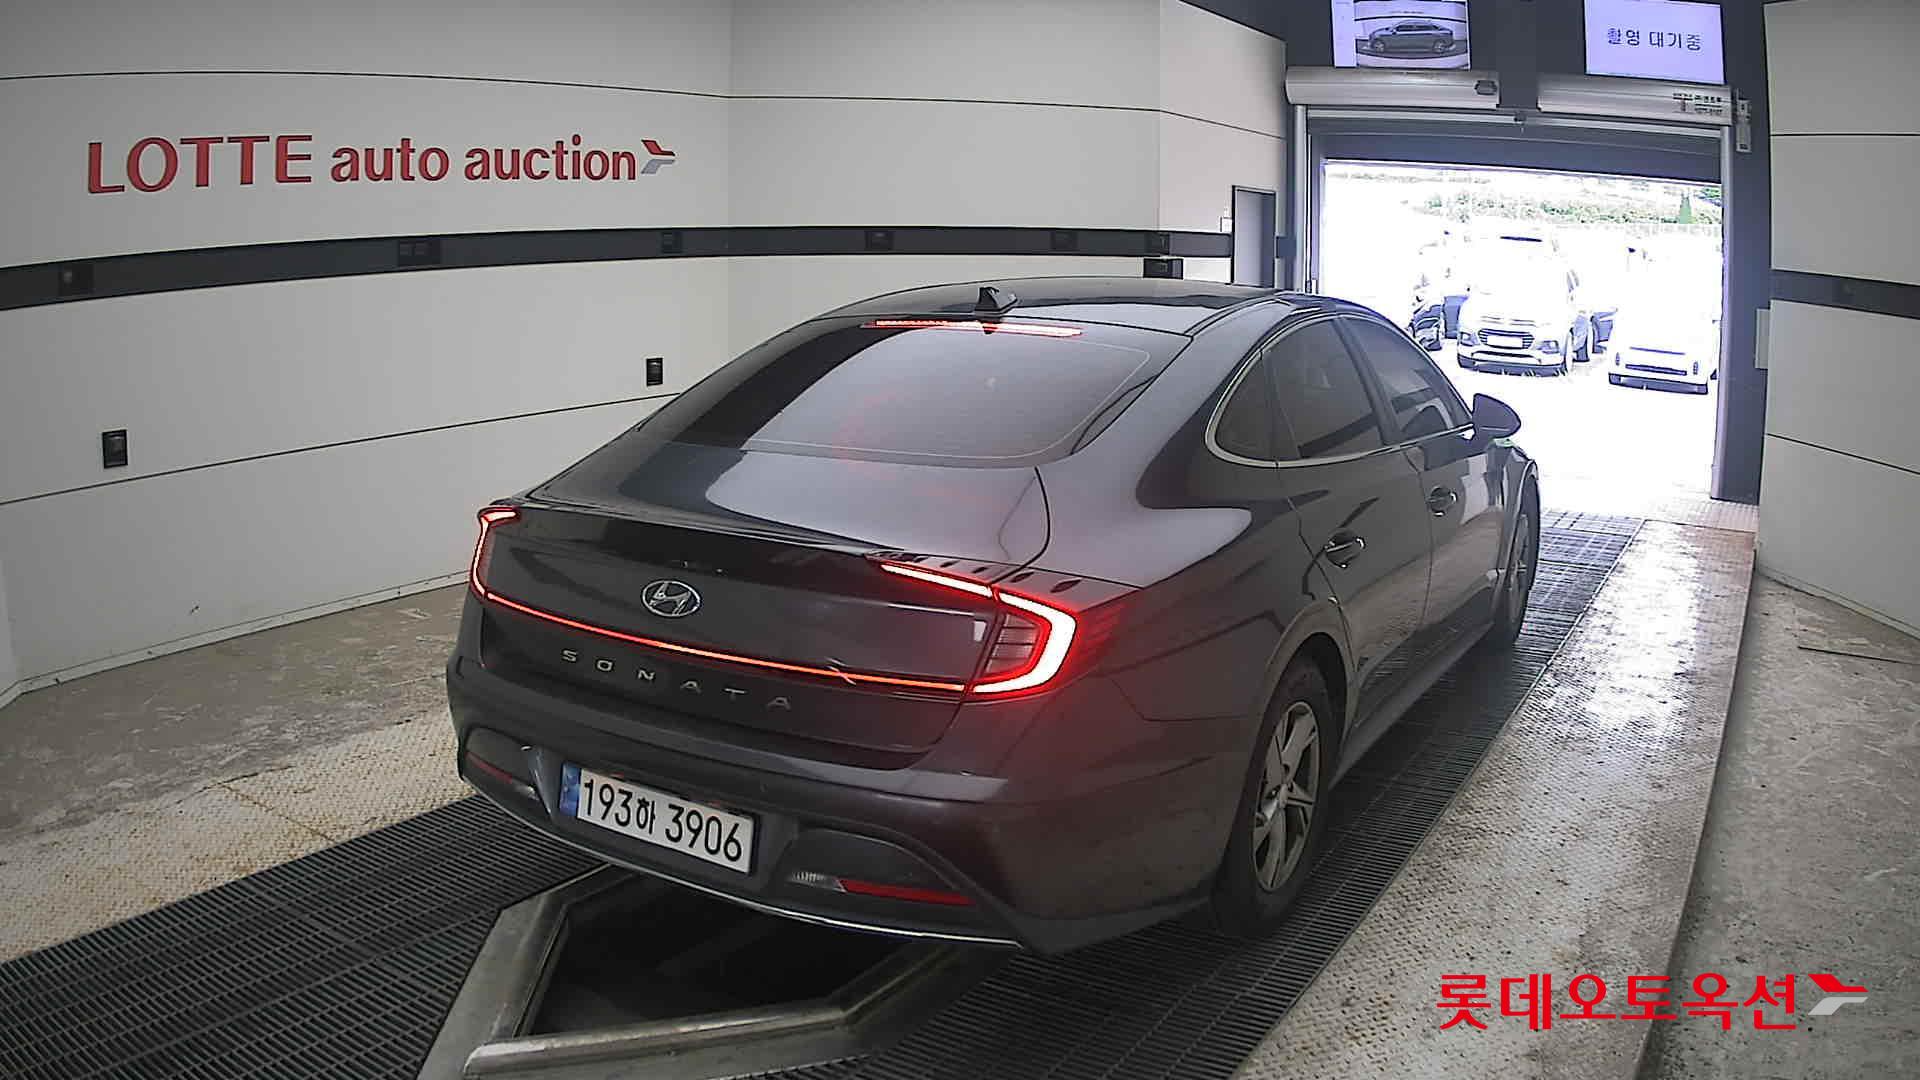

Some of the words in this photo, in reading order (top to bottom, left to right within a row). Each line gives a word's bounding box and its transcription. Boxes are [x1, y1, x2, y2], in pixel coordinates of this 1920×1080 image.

[1648, 31, 1702, 51] 대기중
[88, 135, 313, 194] LOTTE
[330, 138, 450, 182] auto
[464, 134, 637, 181] auction
[562, 649, 791, 710] SONATA
[584, 778, 656, 835] 193하
[665, 803, 742, 862] 3906
